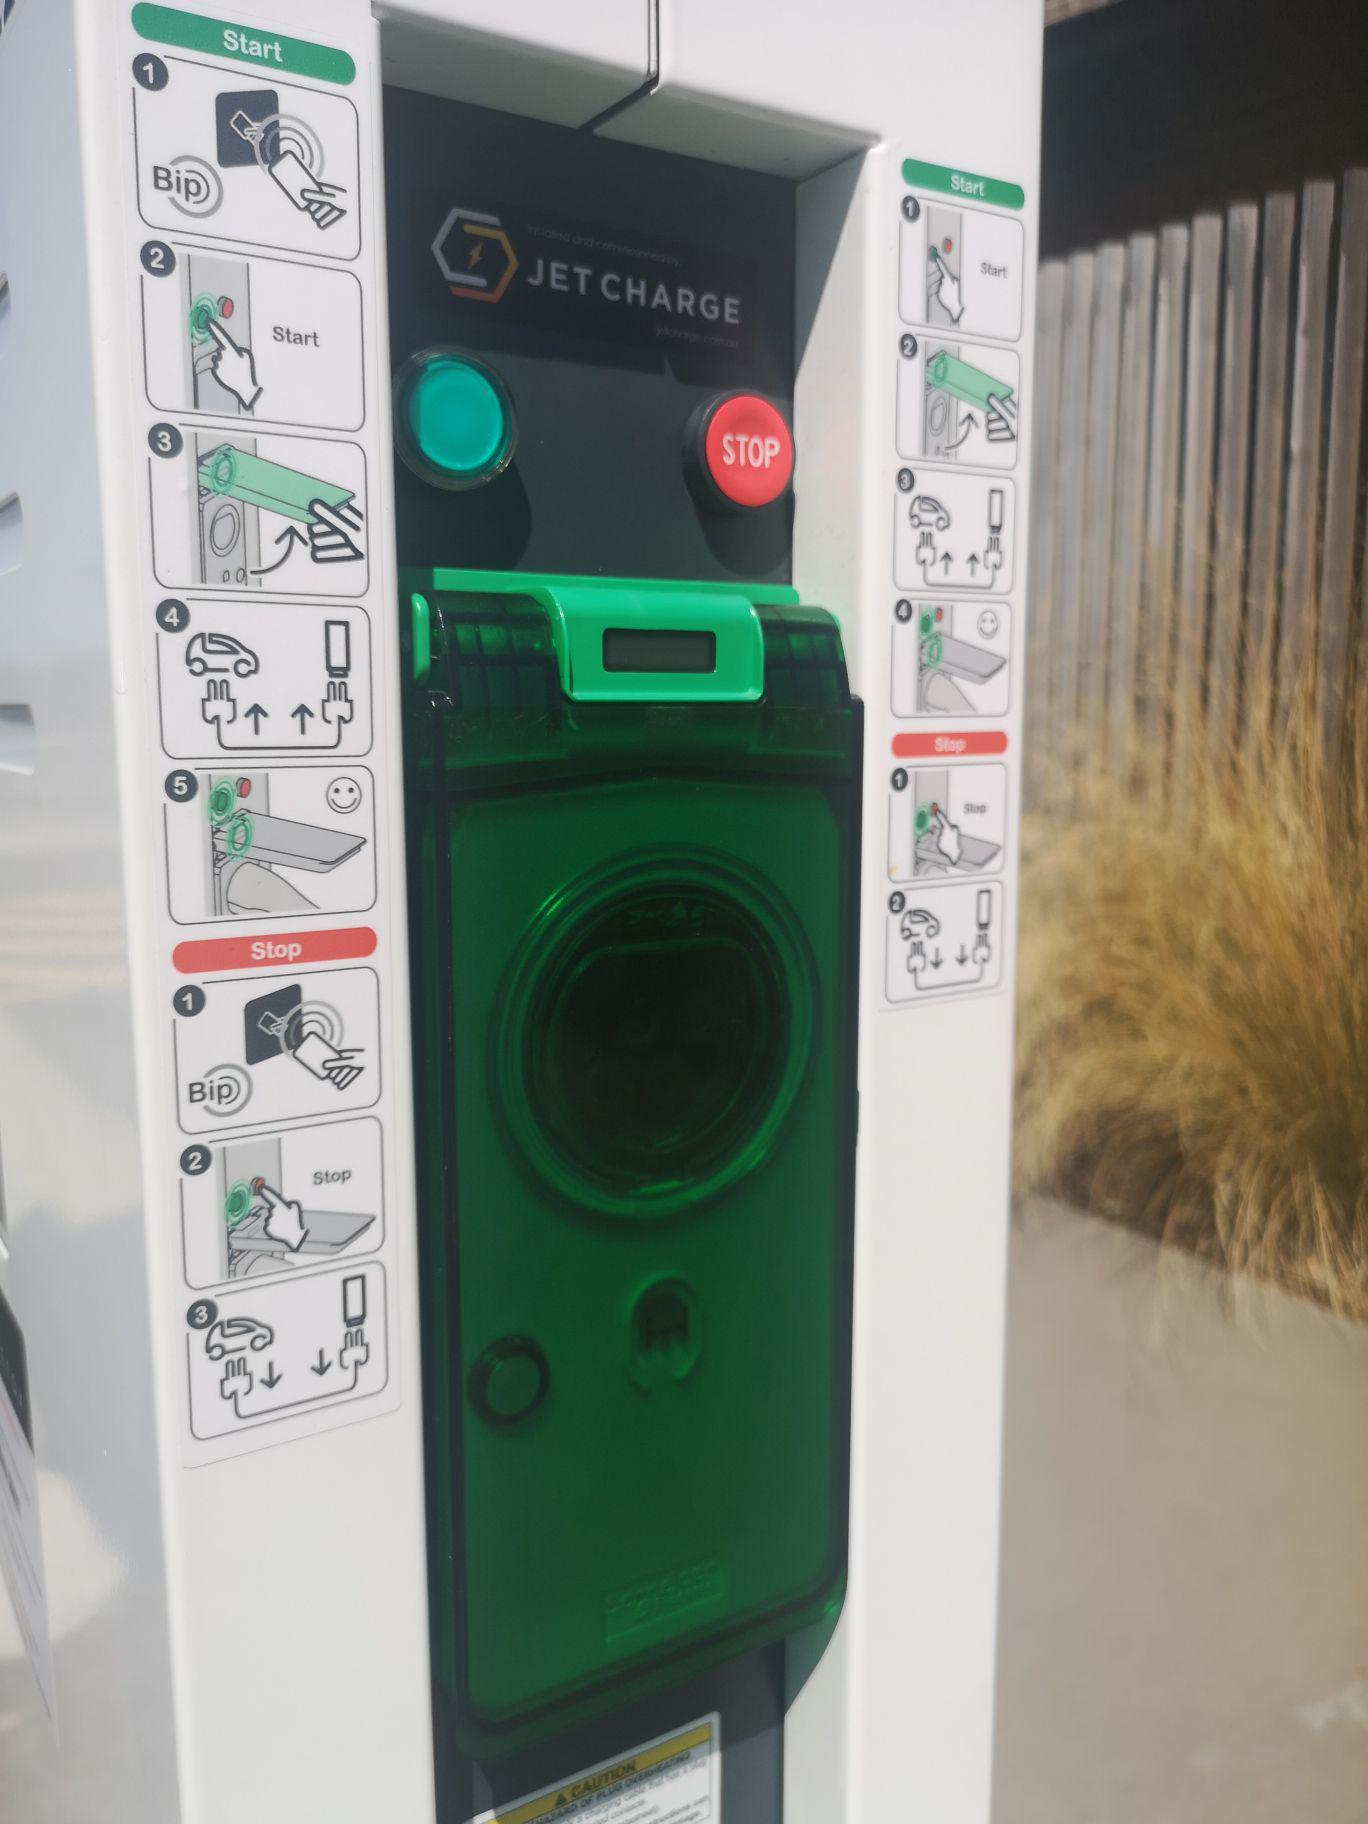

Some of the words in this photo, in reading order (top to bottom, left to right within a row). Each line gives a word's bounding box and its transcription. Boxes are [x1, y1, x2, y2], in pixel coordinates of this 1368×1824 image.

[222, 28, 283, 63] Start
[142, 61, 155, 85] 1
[153, 165, 201, 203] Bip
[950, 174, 985, 198] Start
[905, 199, 915, 217] 1
[149, 247, 165, 271] 2
[981, 261, 1008, 280] Start
[527, 258, 592, 295] JET
[600, 273, 741, 325] CHARGE
[272, 326, 321, 348] Start
[903, 338, 914, 355] 2
[158, 431, 172, 451] 3
[721, 433, 781, 469] STOP
[900, 473, 911, 488] 3
[164, 606, 180, 627] 4
[898, 603, 909, 619] 4
[934, 736, 967, 755] Stop
[173, 775, 188, 795] 5
[894, 772, 904, 788] 1
[963, 803, 987, 816] Stop
[892, 895, 902, 910] 2
[250, 942, 302, 963] Stop
[182, 992, 193, 1011] 1
[188, 1079, 233, 1105] Bip
[189, 1151, 203, 1171] 2
[312, 1169, 352, 1186] Stop
[194, 1304, 209, 1325] 3
[571, 1759, 637, 1799] CAUTION
